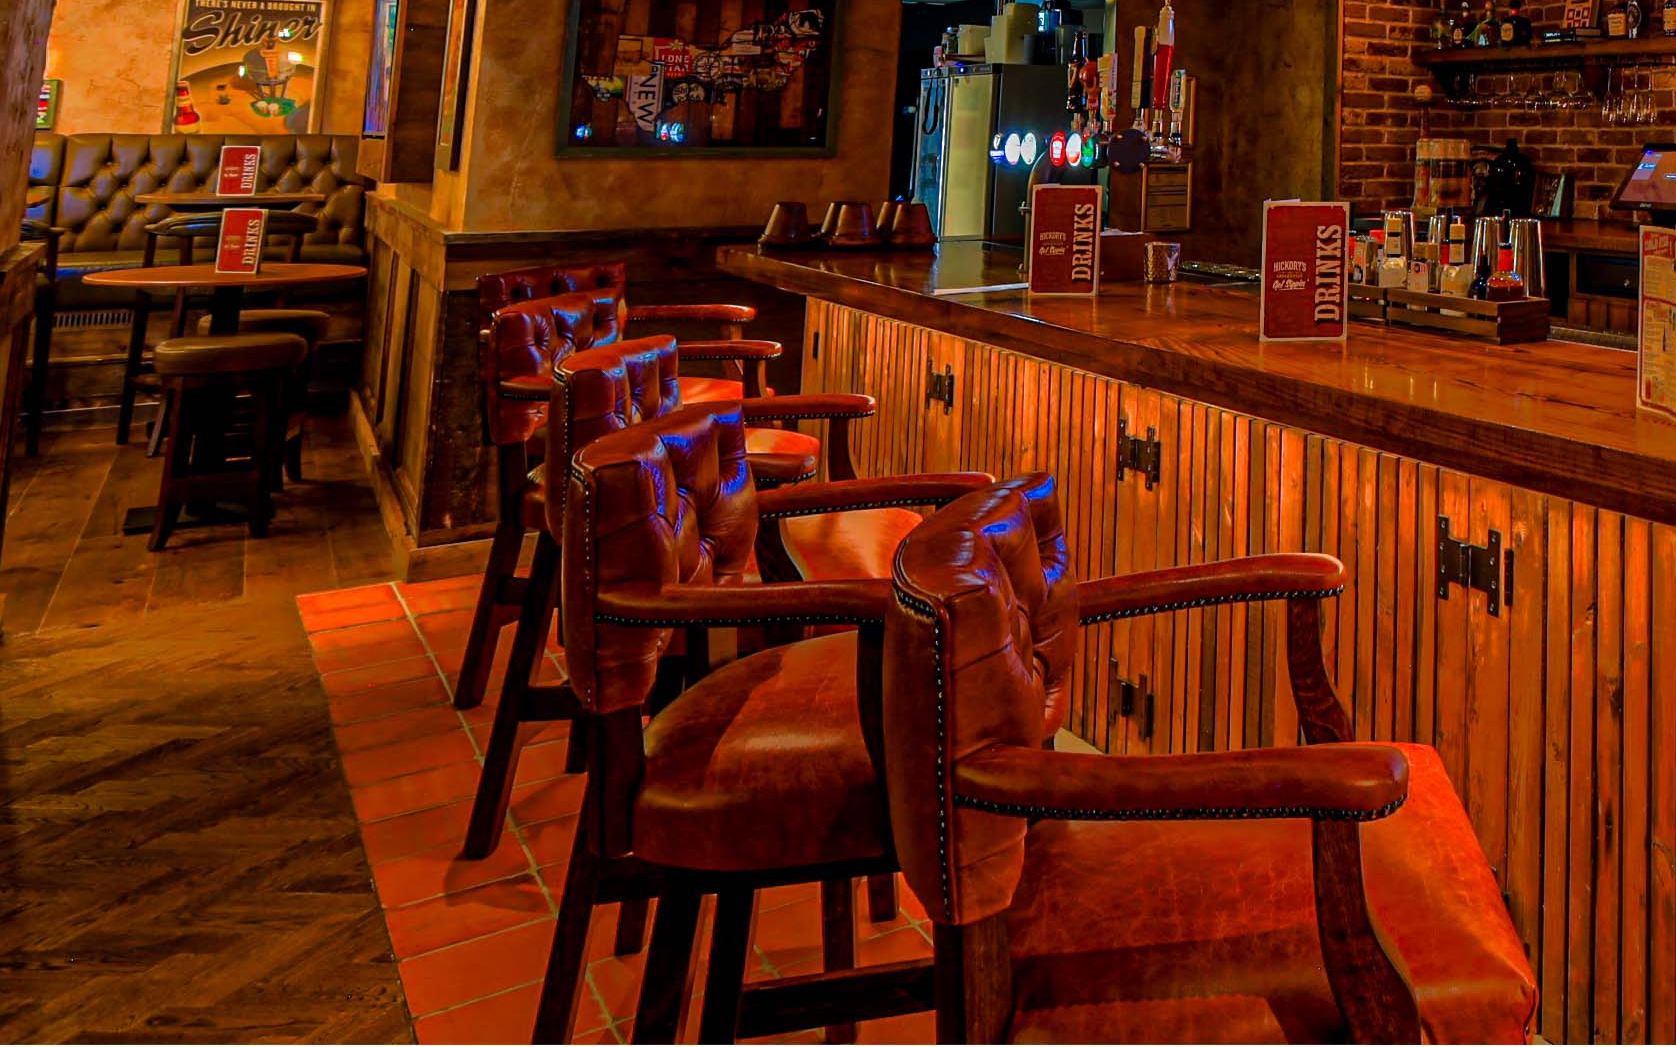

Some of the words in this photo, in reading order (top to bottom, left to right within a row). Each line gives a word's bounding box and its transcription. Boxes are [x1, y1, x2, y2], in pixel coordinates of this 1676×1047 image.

[231, 0, 258, 10] NEVER
[259, 1, 266, 10] A
[266, 1, 305, 12] DROUGHT
[306, 3, 316, 12] IN
[181, 10, 324, 57] Shiner
[241, 153, 257, 190] DRINKS
[241, 218, 261, 266] DRINKS
[1071, 203, 1095, 282] DRINKS
[1314, 223, 1342, 323] DRINKS
